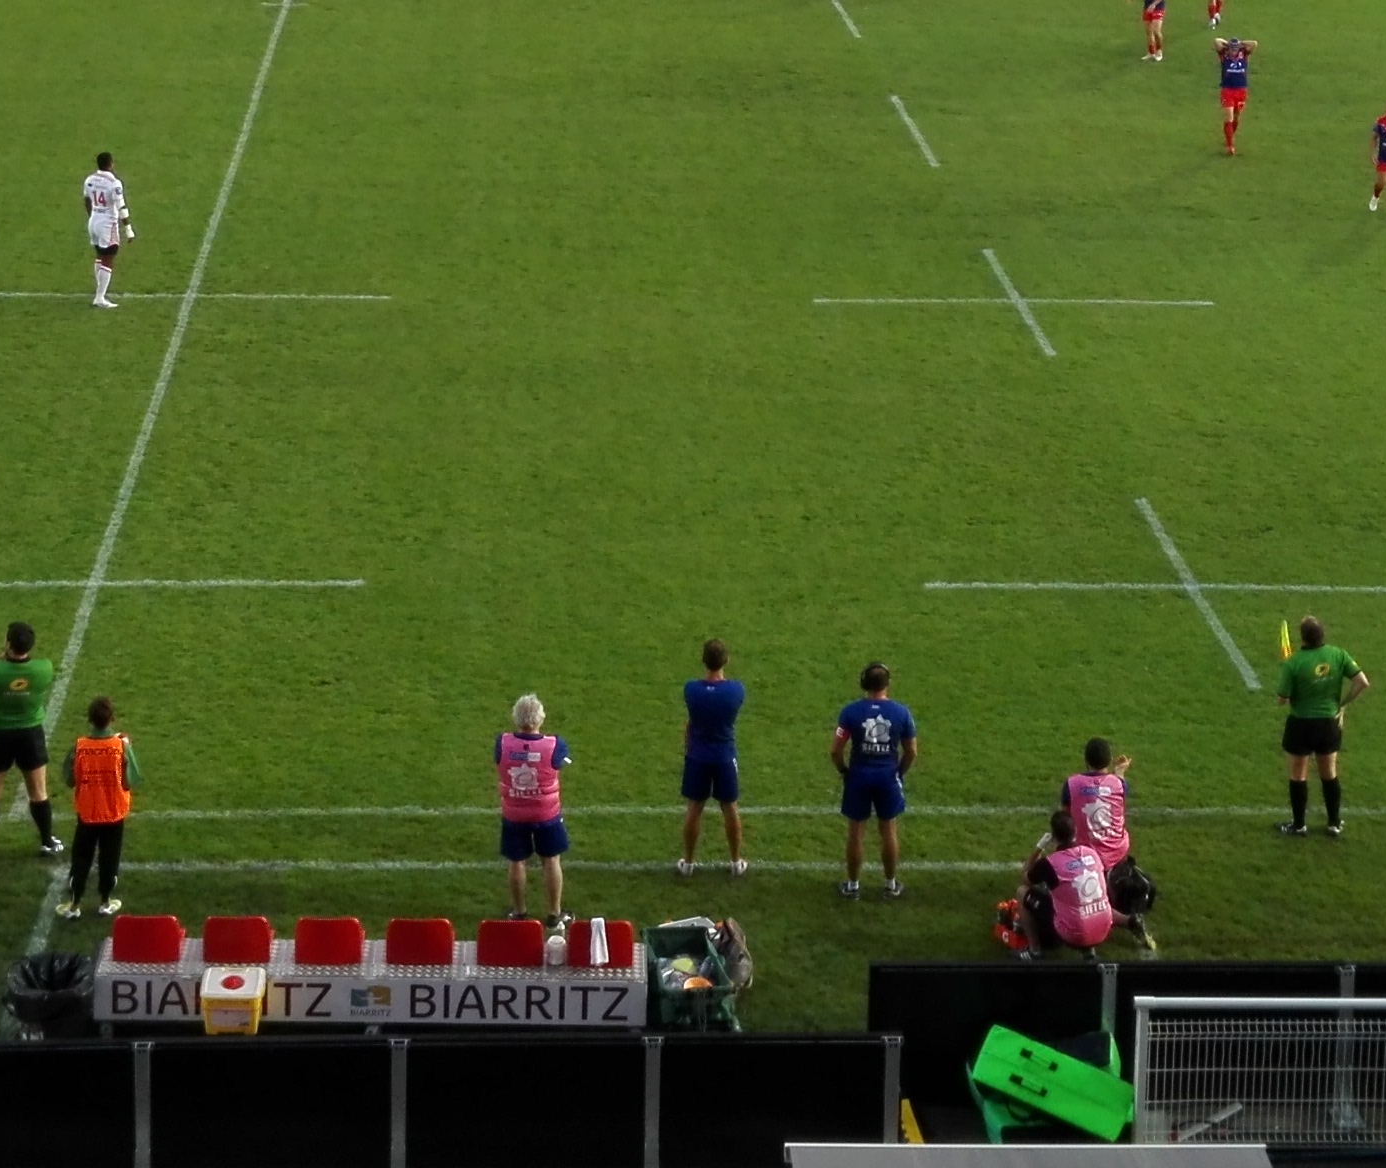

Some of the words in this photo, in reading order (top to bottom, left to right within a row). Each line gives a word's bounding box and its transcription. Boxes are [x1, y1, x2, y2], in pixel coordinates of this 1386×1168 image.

[92, 191, 106, 207] 14
[112, 981, 332, 1017] BIAITZ
[410, 984, 629, 1020] BIARRITZ
